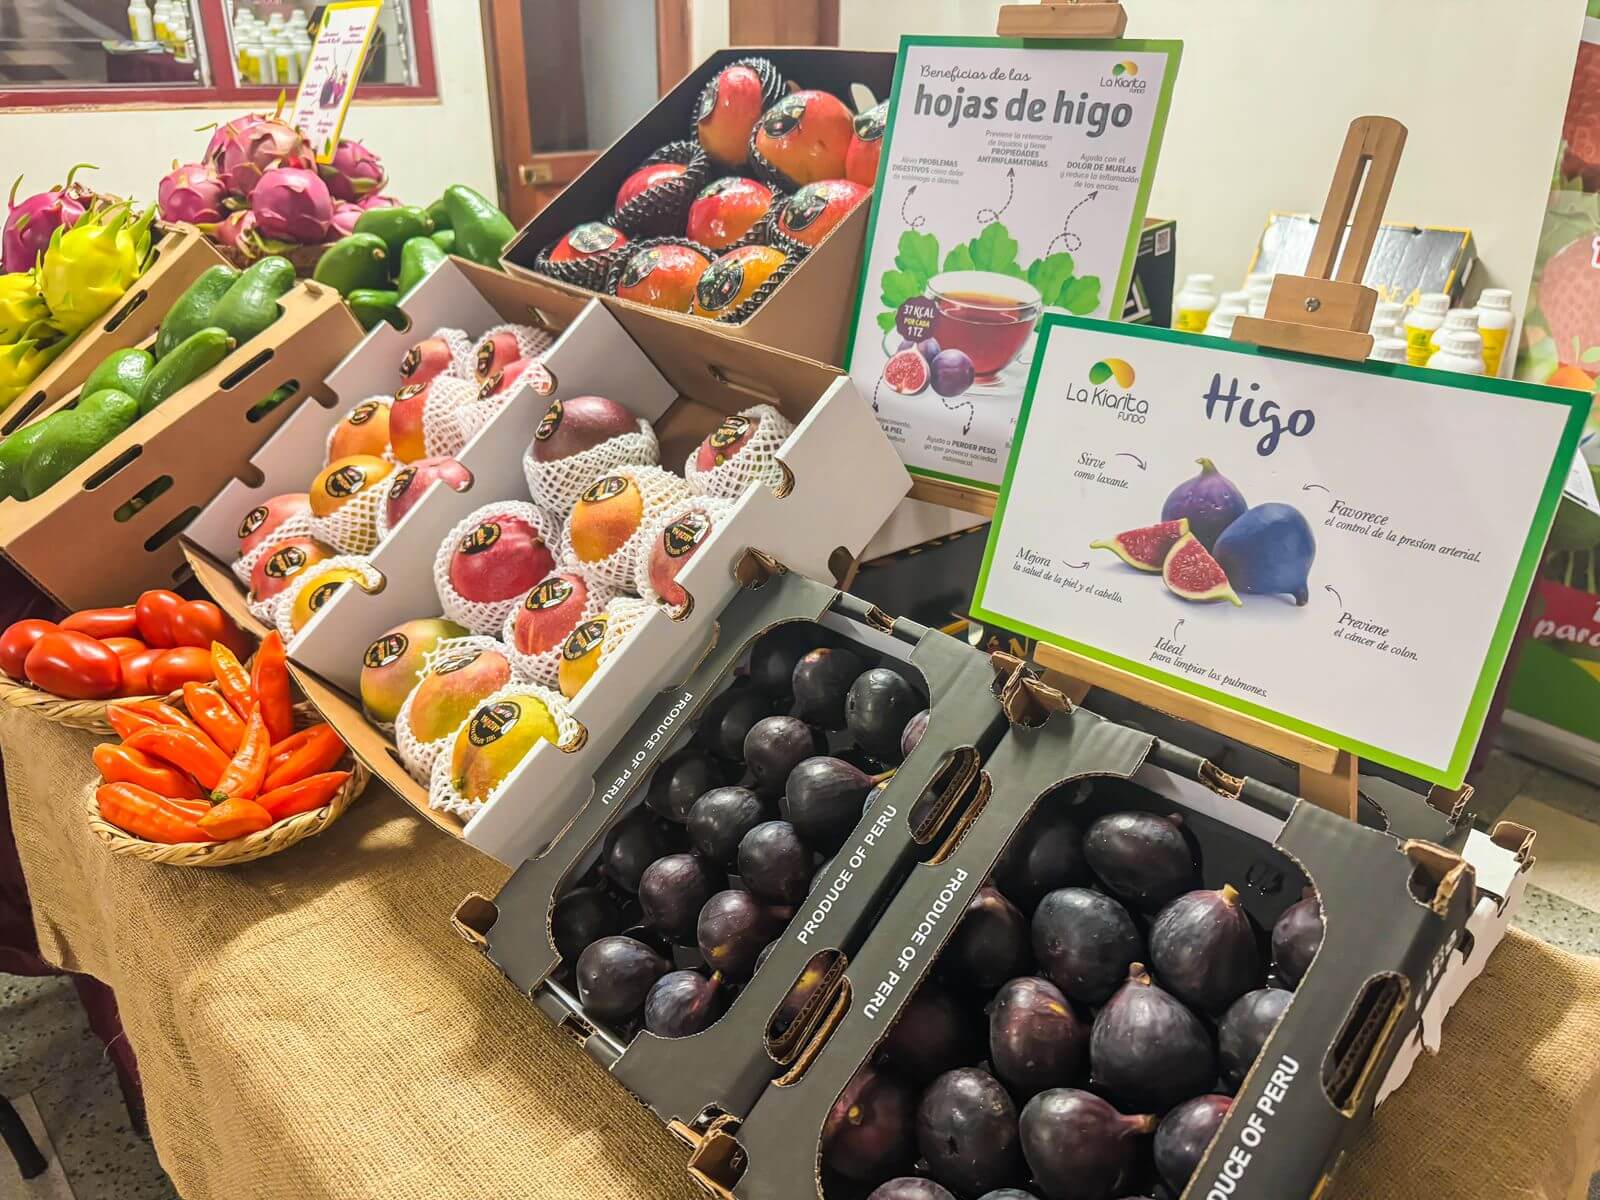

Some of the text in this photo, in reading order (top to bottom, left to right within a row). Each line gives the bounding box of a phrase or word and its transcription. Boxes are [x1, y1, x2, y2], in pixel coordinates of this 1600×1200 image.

[989, 66, 1007, 81] de
[1008, 68, 1031, 82] las
[914, 83, 1133, 138] hojas de higo
[918, 158, 958, 167] PROBLEMAS
[1066, 161, 1137, 174] DOLOR DE MUELAS
[1080, 152, 1103, 162] Ayuda
[1104, 155, 1117, 163] con
[903, 304, 934, 319] 37 KCAL
[907, 326, 923, 337] 1 TZ
[1066, 382, 1149, 414] La Kiarita
[1202, 372, 1315, 457] Higo
[952, 439, 978, 451] PERDER
[1077, 451, 1106, 469] Sirve
[1073, 469, 1129, 489] como laxante.
[1328, 499, 1389, 526] Favorece
[1324, 516, 1336, 526] el
[1335, 519, 1372, 535] control
[1371, 527, 1384, 539] de
[1385, 530, 1397, 542] la
[1438, 543, 1482, 563] arterial.
[1015, 546, 1051, 567] Mejora
[1012, 561, 1123, 604] la salud de la piel y el cabello.
[1337, 611, 1389, 637] Previene
[1153, 636, 1186, 656] Ideal
[1333, 627, 1418, 661] el cáncer de colon.
[1149, 650, 1268, 698] para limpiar los pulmones.
[601, 692, 693, 805] PRODUCE OF PERU
[797, 805, 897, 945] PRODUCE OF PERU
[863, 867, 969, 1020] PRODUCE OF PERU
[1240, 1112, 1266, 1148] OF
[1256, 1054, 1299, 1117] PERU
